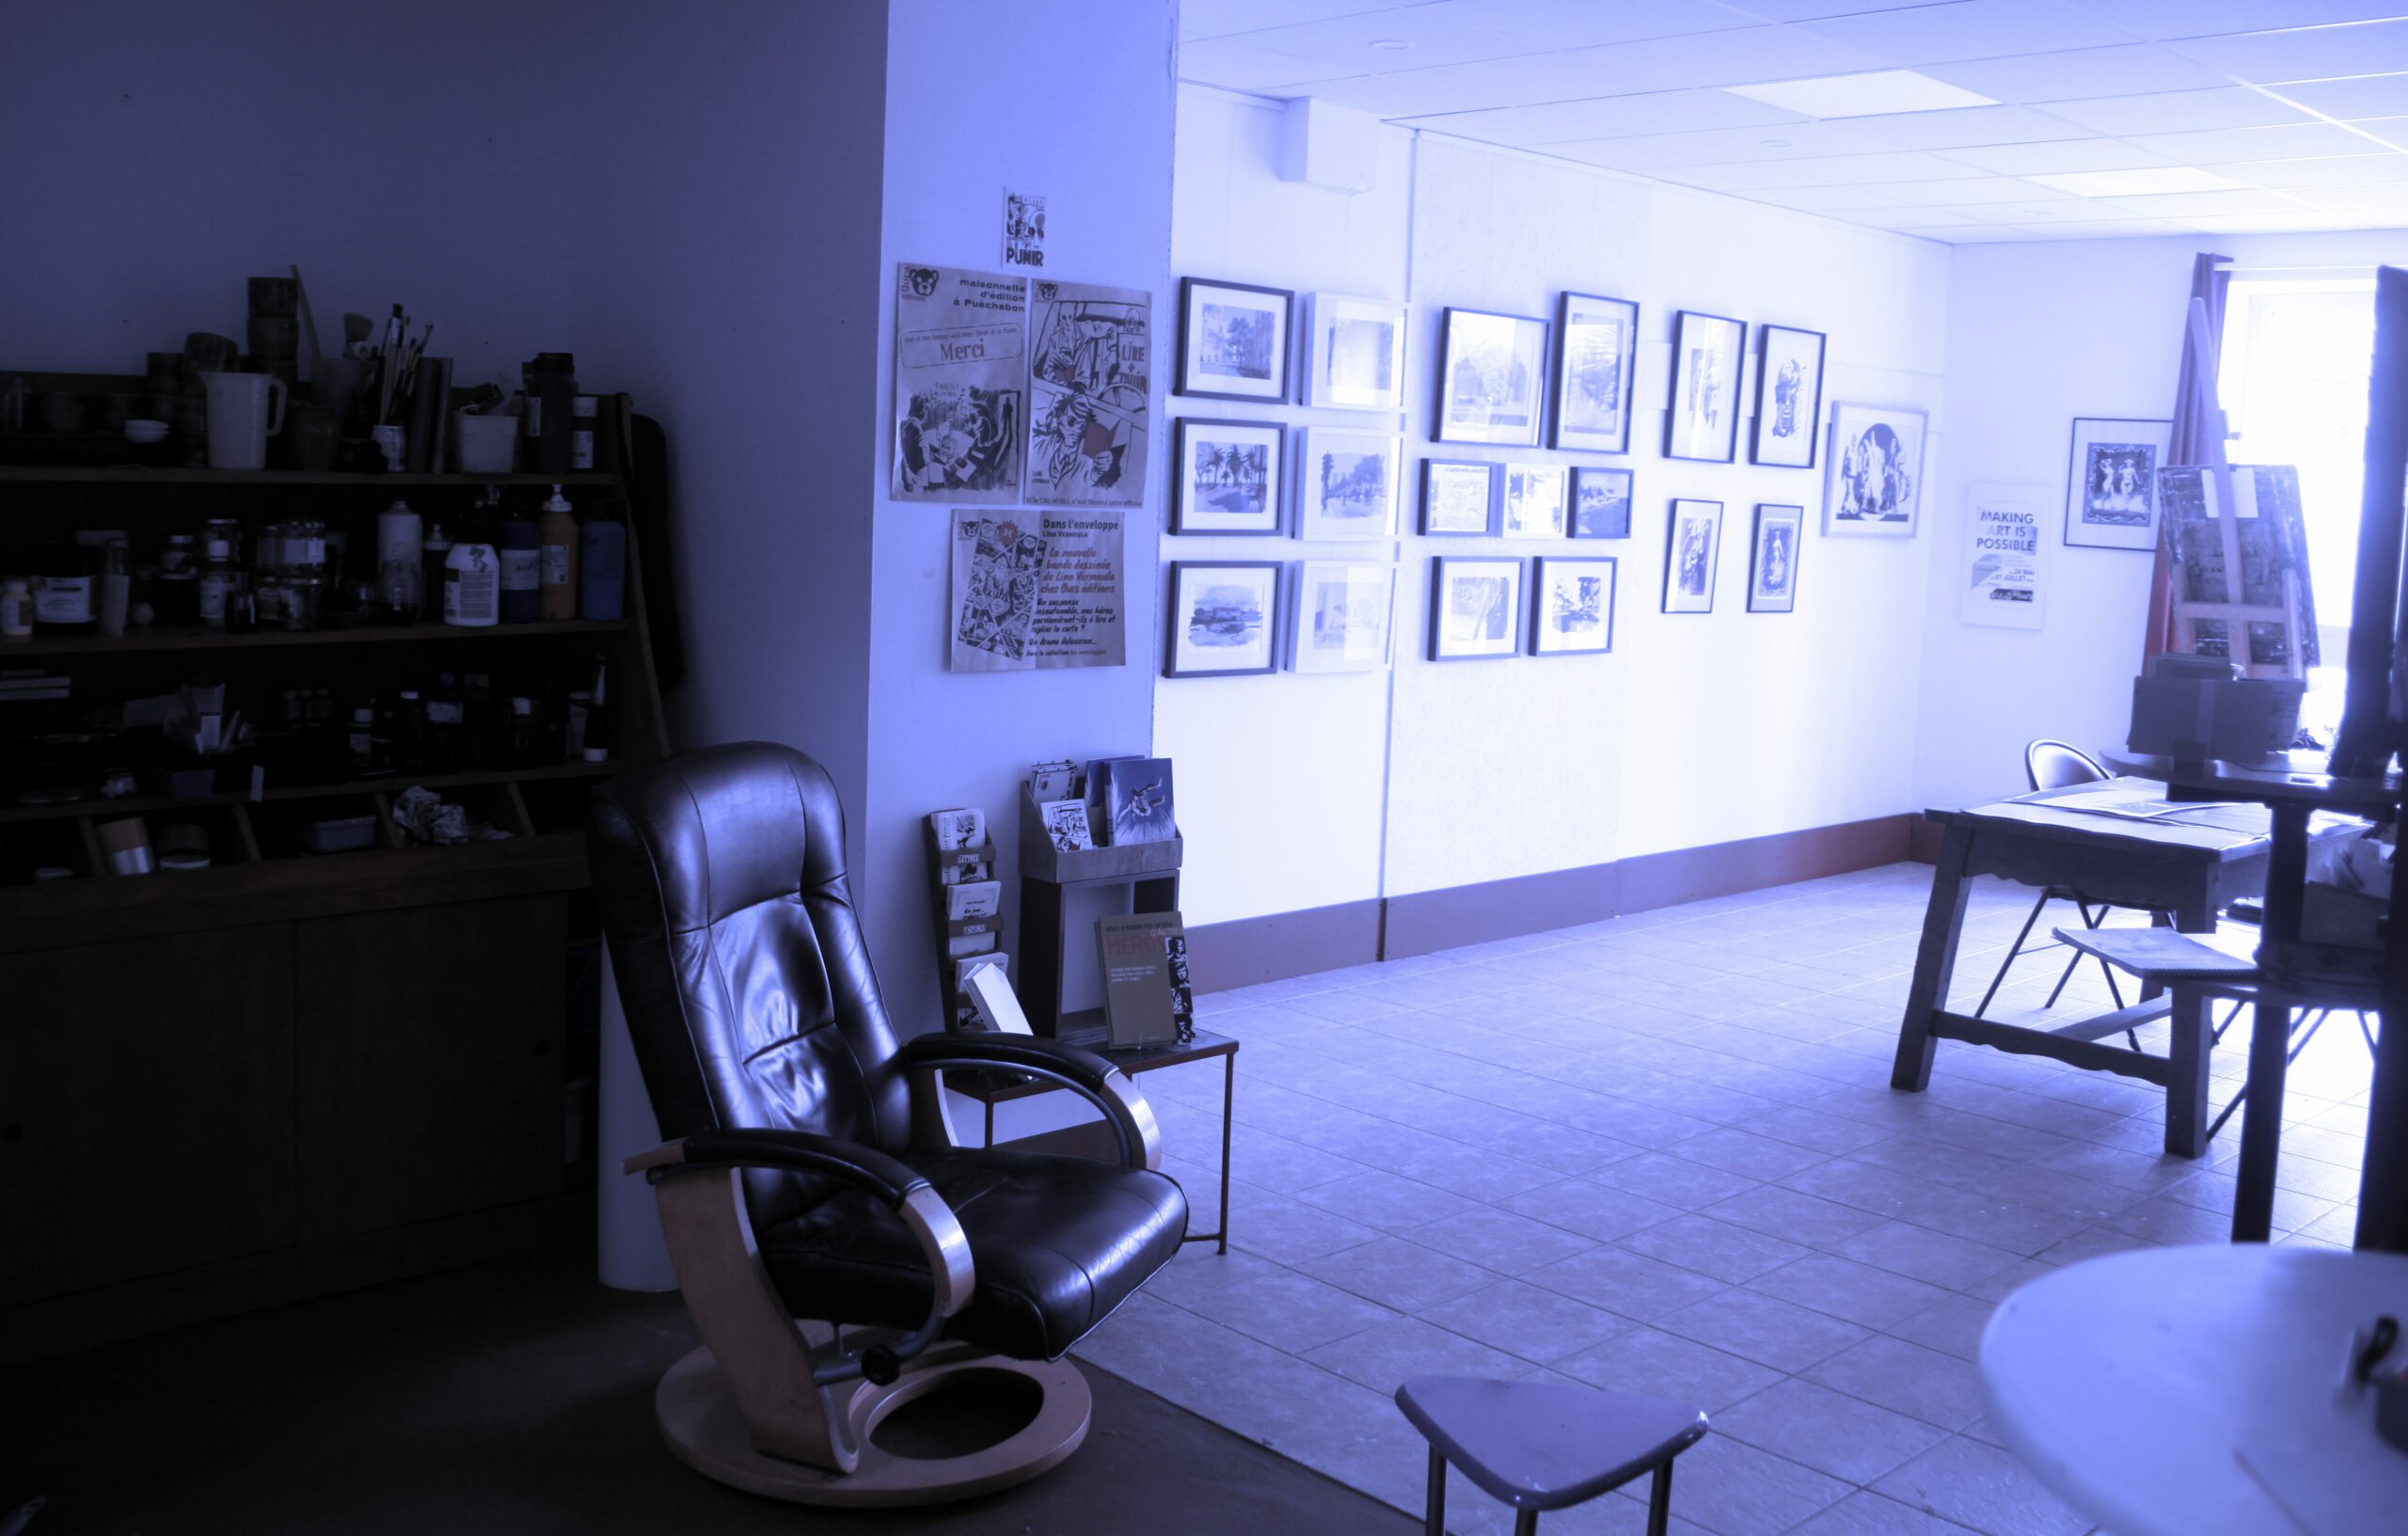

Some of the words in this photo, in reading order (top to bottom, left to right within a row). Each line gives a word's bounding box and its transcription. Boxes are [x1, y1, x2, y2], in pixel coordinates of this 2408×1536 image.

[1006, 247, 1044, 267] PUNIR
[958, 278, 1026, 293] maisonnette
[952, 295, 960, 306] à
[964, 298, 1025, 313] Puéchabon
[979, 291, 1025, 303] d'édition
[940, 338, 985, 362] Merci
[1980, 511, 2034, 524] MAKING
[1043, 519, 1066, 529] Dans
[1069, 519, 1119, 531] l'enveloppe
[1987, 525, 2011, 536] ART
[2015, 526, 2026, 537] IS
[1976, 537, 2034, 551] POSSIBLE
